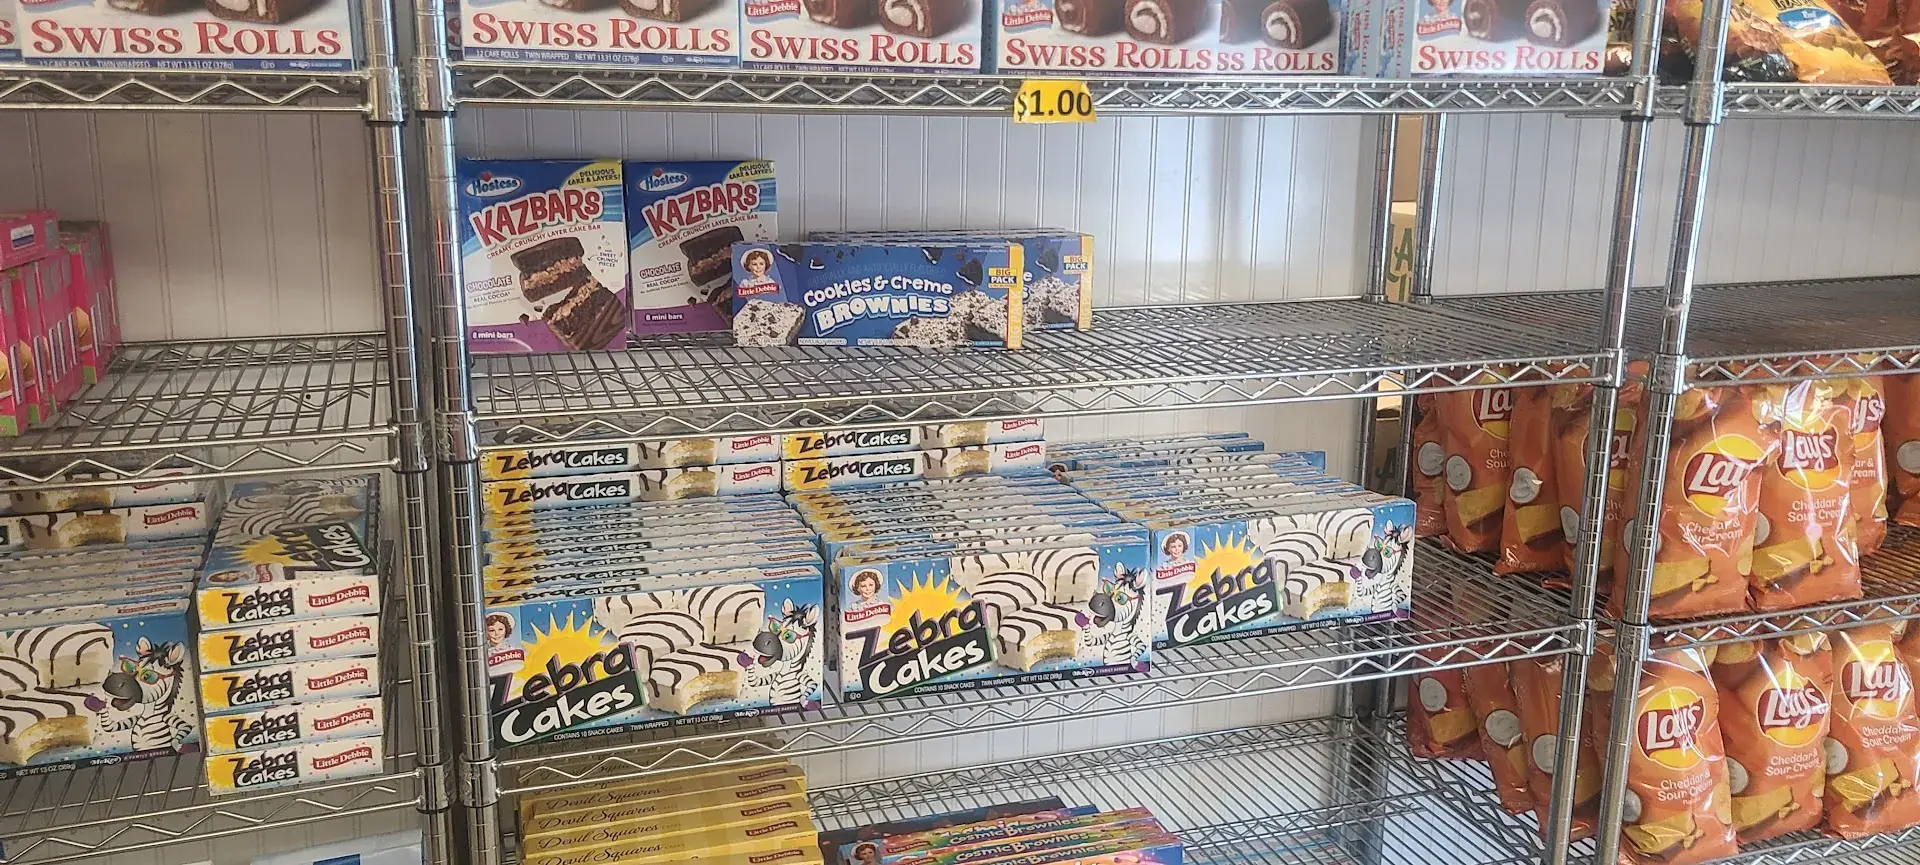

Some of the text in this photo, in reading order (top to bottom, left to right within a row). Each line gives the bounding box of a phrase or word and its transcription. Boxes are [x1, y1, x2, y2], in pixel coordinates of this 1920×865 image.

[748, 2, 798, 16] Little Debbie
[31, 19, 183, 54] SWISS
[193, 21, 342, 55] ROLLS
[472, 12, 598, 47] SWISS
[608, 18, 731, 52] ROLLS
[500, 51, 519, 59] ROLLS
[525, 52, 541, 60] TWIN
[541, 52, 569, 60] WRAPPED
[750, 29, 974, 65] SWISS ROLLS
[1006, 38, 1106, 68] SWISS
[1114, 41, 1211, 70] ROLLS
[1252, 47, 1333, 71] ROLLS
[1418, 45, 1599, 71] SWISS ROLLS
[1017, 89, 1092, 121] $1.00
[739, 163, 771, 172] DELICIOUS
[471, 178, 518, 195] Hostess
[568, 174, 621, 186] CAKE LAYERS!
[645, 174, 686, 191] Hostess
[472, 189, 601, 247] KAZBARS
[645, 183, 758, 238] KAZBARS
[683, 223, 711, 238] CRUNCHY
[711, 219, 730, 229] LAYER
[730, 215, 746, 223] CAKE
[486, 245, 515, 260] CREAMY,
[515, 233, 546, 248] CRUNCHY
[547, 228, 568, 239] LAYER
[599, 251, 617, 259] SWEET
[640, 262, 682, 279] CHOCOLATE
[995, 268, 1011, 276] BIG
[1065, 262, 1087, 270] PACK
[466, 275, 512, 293] CHOCOLATE
[873, 275, 889, 291] &
[991, 276, 1015, 284] PACK
[738, 285, 777, 296] Little Debbie
[816, 295, 949, 331] BROWNIES
[478, 331, 496, 339] mini
[796, 431, 908, 454] Zebra Cakes
[496, 450, 625, 474] Zebra Cakes
[800, 461, 912, 484] Zebra Cakes
[498, 482, 627, 507] Zebra Cakes
[318, 525, 371, 568] Cakes
[508, 546, 585, 561] Zebra
[496, 572, 577, 588] Zebra
[1157, 565, 1194, 578] Little Debbie
[221, 586, 293, 610] Zebra
[311, 588, 368, 606] Little Debbie
[485, 589, 566, 605] Zebra
[1156, 556, 1275, 621] Zebra
[231, 603, 292, 622] Cakes
[846, 606, 889, 622] Little Debbie
[1173, 593, 1272, 643] Cakes
[224, 628, 294, 650] Zebra
[313, 629, 368, 648] Little Debbie
[845, 599, 986, 668] Zebra
[232, 645, 293, 664] Cakes
[494, 652, 522, 666] Debbie
[868, 639, 985, 694] Cakes
[222, 668, 293, 692] Zebra
[311, 671, 365, 689] Little Debbie
[490, 642, 637, 714] Zebra
[914, 685, 938, 694] CONTAINS
[959, 681, 975, 689] CAKES
[993, 677, 1015, 686] WRAPPED
[1020, 675, 1030, 683] NET
[231, 686, 291, 705] Cakes
[229, 711, 299, 734] Zebra
[316, 711, 371, 729] Little Debbie
[500, 684, 634, 743] Cakes
[237, 729, 296, 747] Cakes
[553, 731, 580, 741] CONTAINS
[606, 726, 624, 735] CAKES
[91, 756, 121, 765] McKee
[228, 750, 298, 773] Zebra
[316, 750, 369, 768] Little Debbie
[1770, 751, 1813, 767] Cheddar
[237, 767, 296, 786] Cakes
[1660, 769, 1711, 790] Cheddar &
[1765, 764, 1793, 776] Sour
[546, 788, 661, 810] Devil Squares
[1657, 788, 1687, 802] Sour
[538, 804, 656, 830] Devil Squares
[743, 808, 763, 816] Little
[538, 824, 659, 849] Devil Squares
[749, 827, 769, 836] Little
[950, 828, 1004, 844] Cosmic
[1002, 818, 1081, 837] Brownies
[593, 843, 663, 862] Squares
[955, 831, 1089, 861] Cosmic Brownies
[1025, 844, 1106, 865] Brownies
[752, 850, 800, 863] Little Debbie
